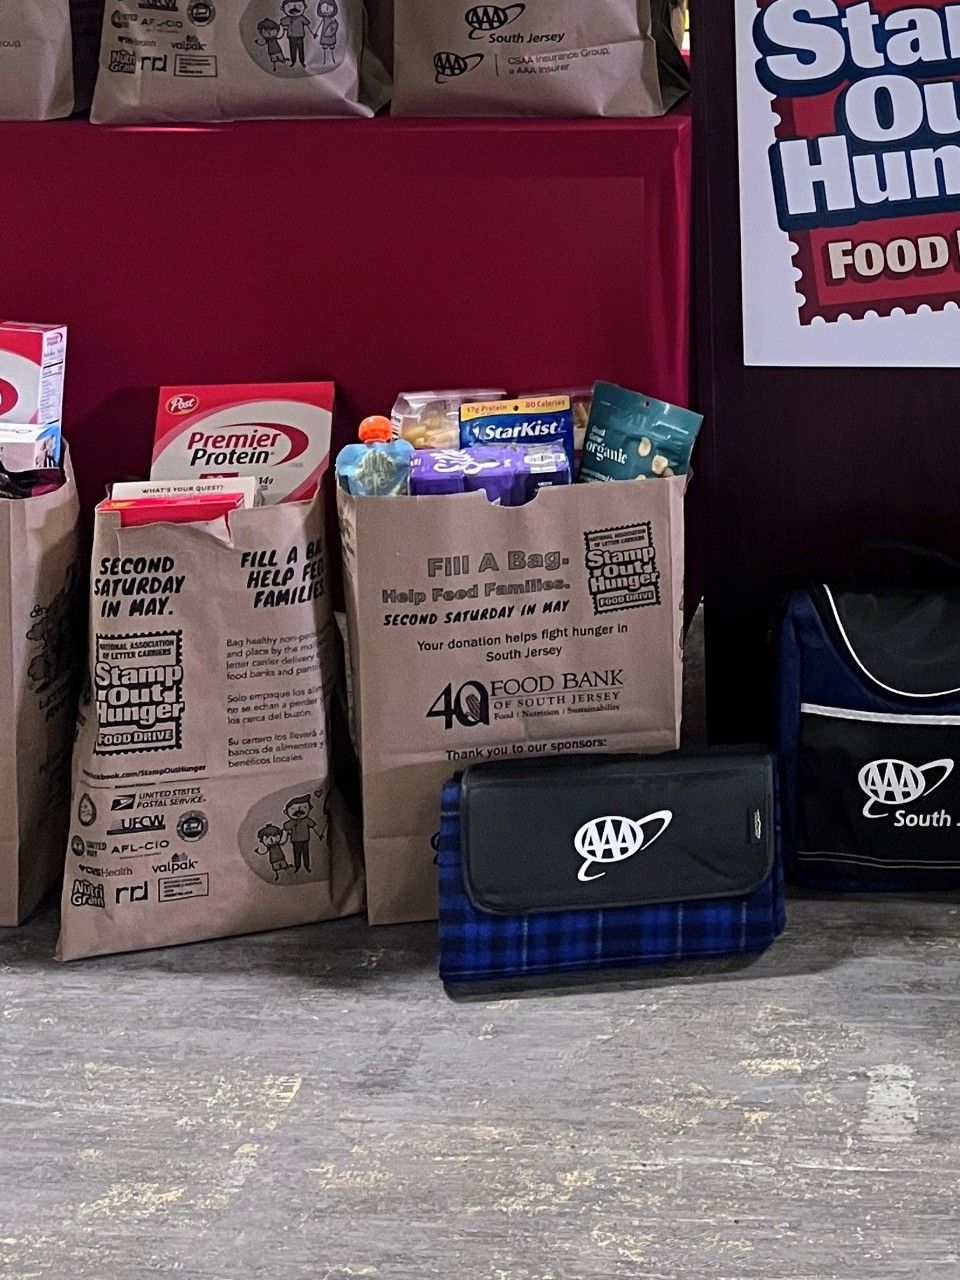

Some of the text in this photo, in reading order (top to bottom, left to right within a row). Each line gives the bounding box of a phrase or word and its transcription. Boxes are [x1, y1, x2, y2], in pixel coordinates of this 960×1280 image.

[465, 5, 508, 30] AAA
[489, 33, 566, 44] South Jersey
[828, 235, 950, 279] FOOD
[171, 398, 196, 412] Post
[188, 430, 281, 450] Premier
[484, 421, 558, 440] StarKist
[190, 447, 270, 467] Protein
[586, 440, 628, 465] organic
[142, 486, 171, 494] WHAT'S
[195, 484, 224, 492] QUEST?
[100, 557, 174, 575] SECOND
[427, 550, 570, 578] Fill A Bag.
[94, 576, 185, 597] SATURDAY
[101, 597, 173, 617] IN MAY.
[491, 669, 624, 697] FOOD BANK
[858, 759, 926, 805] AAA
[894, 810, 950, 827] South
[574, 816, 644, 863] AAA
